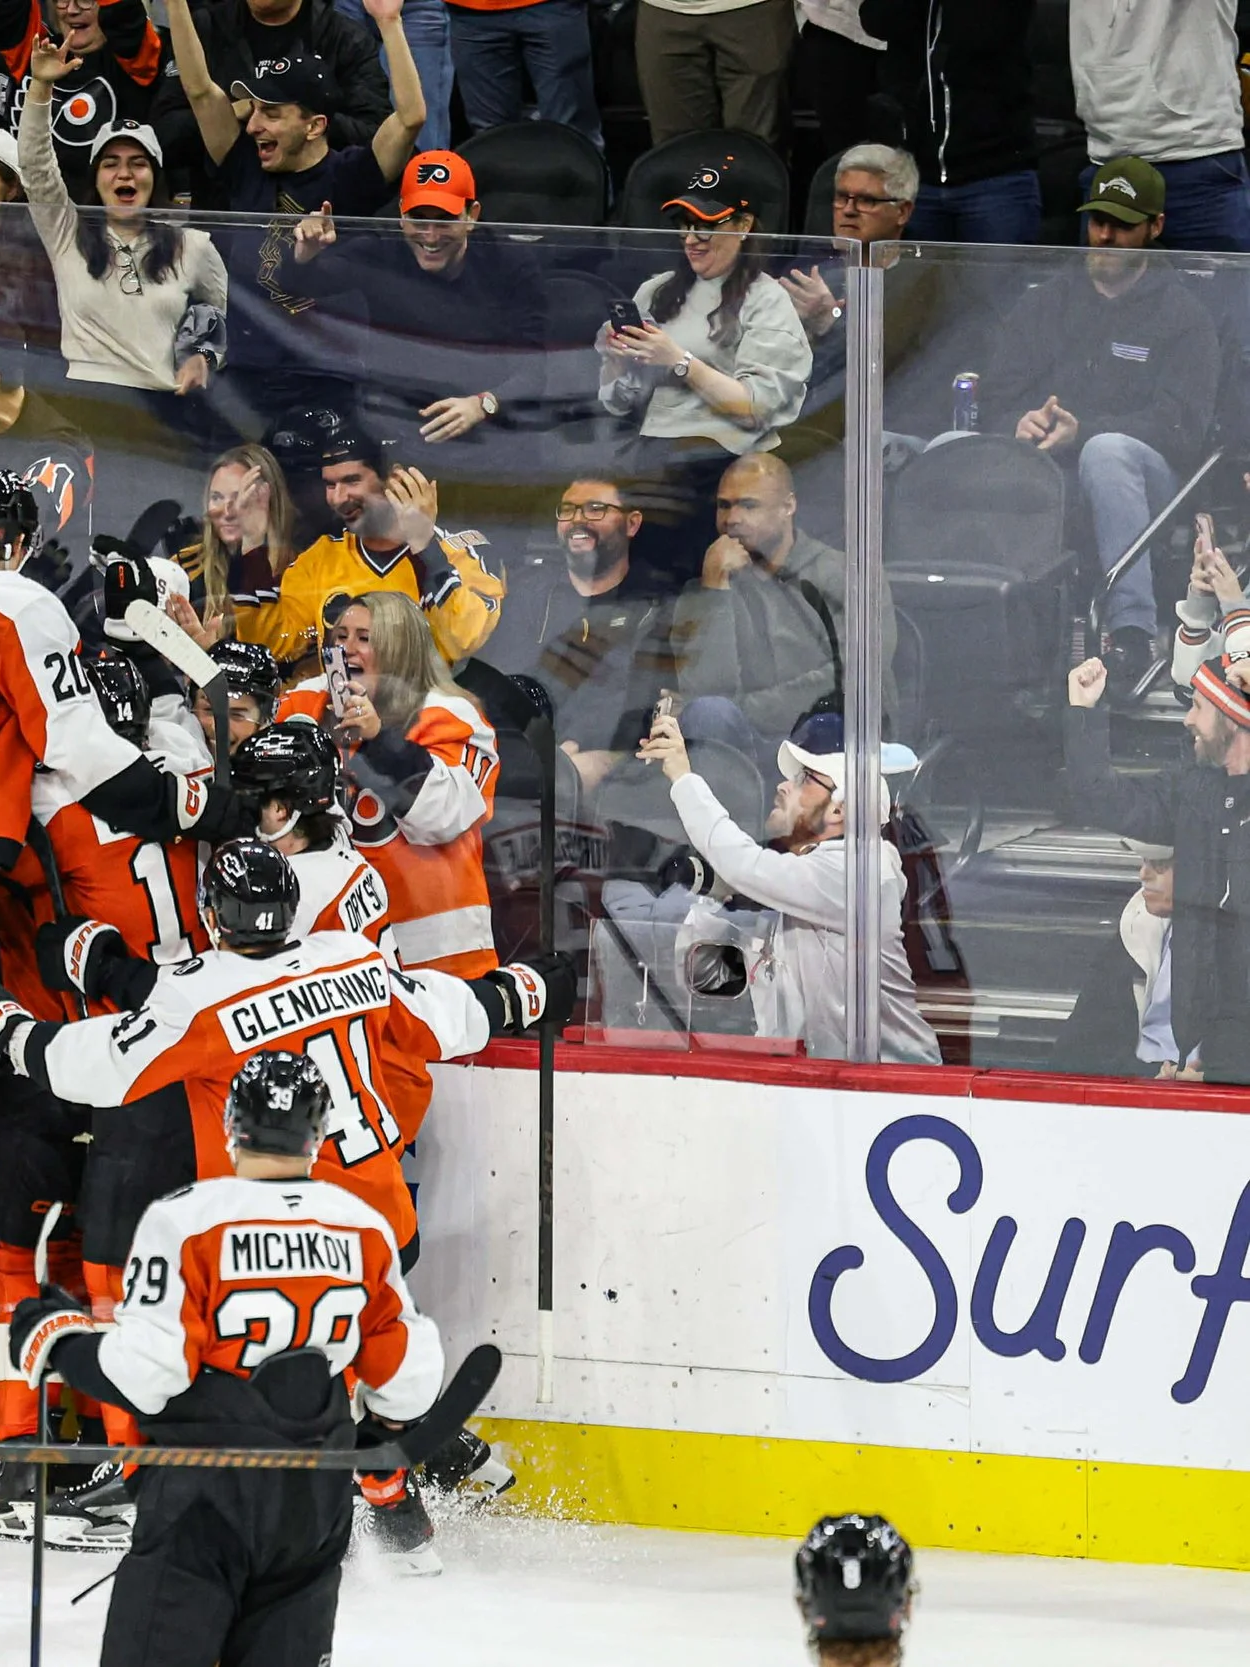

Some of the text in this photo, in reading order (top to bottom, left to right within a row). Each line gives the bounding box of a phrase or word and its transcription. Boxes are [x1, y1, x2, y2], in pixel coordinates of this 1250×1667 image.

[43, 648, 91, 703] 20
[116, 701, 133, 722] 14
[255, 911, 274, 931] 41
[231, 966, 387, 1043] GLENDENING
[266, 1086, 294, 1111] 39
[303, 1014, 401, 1169] 41
